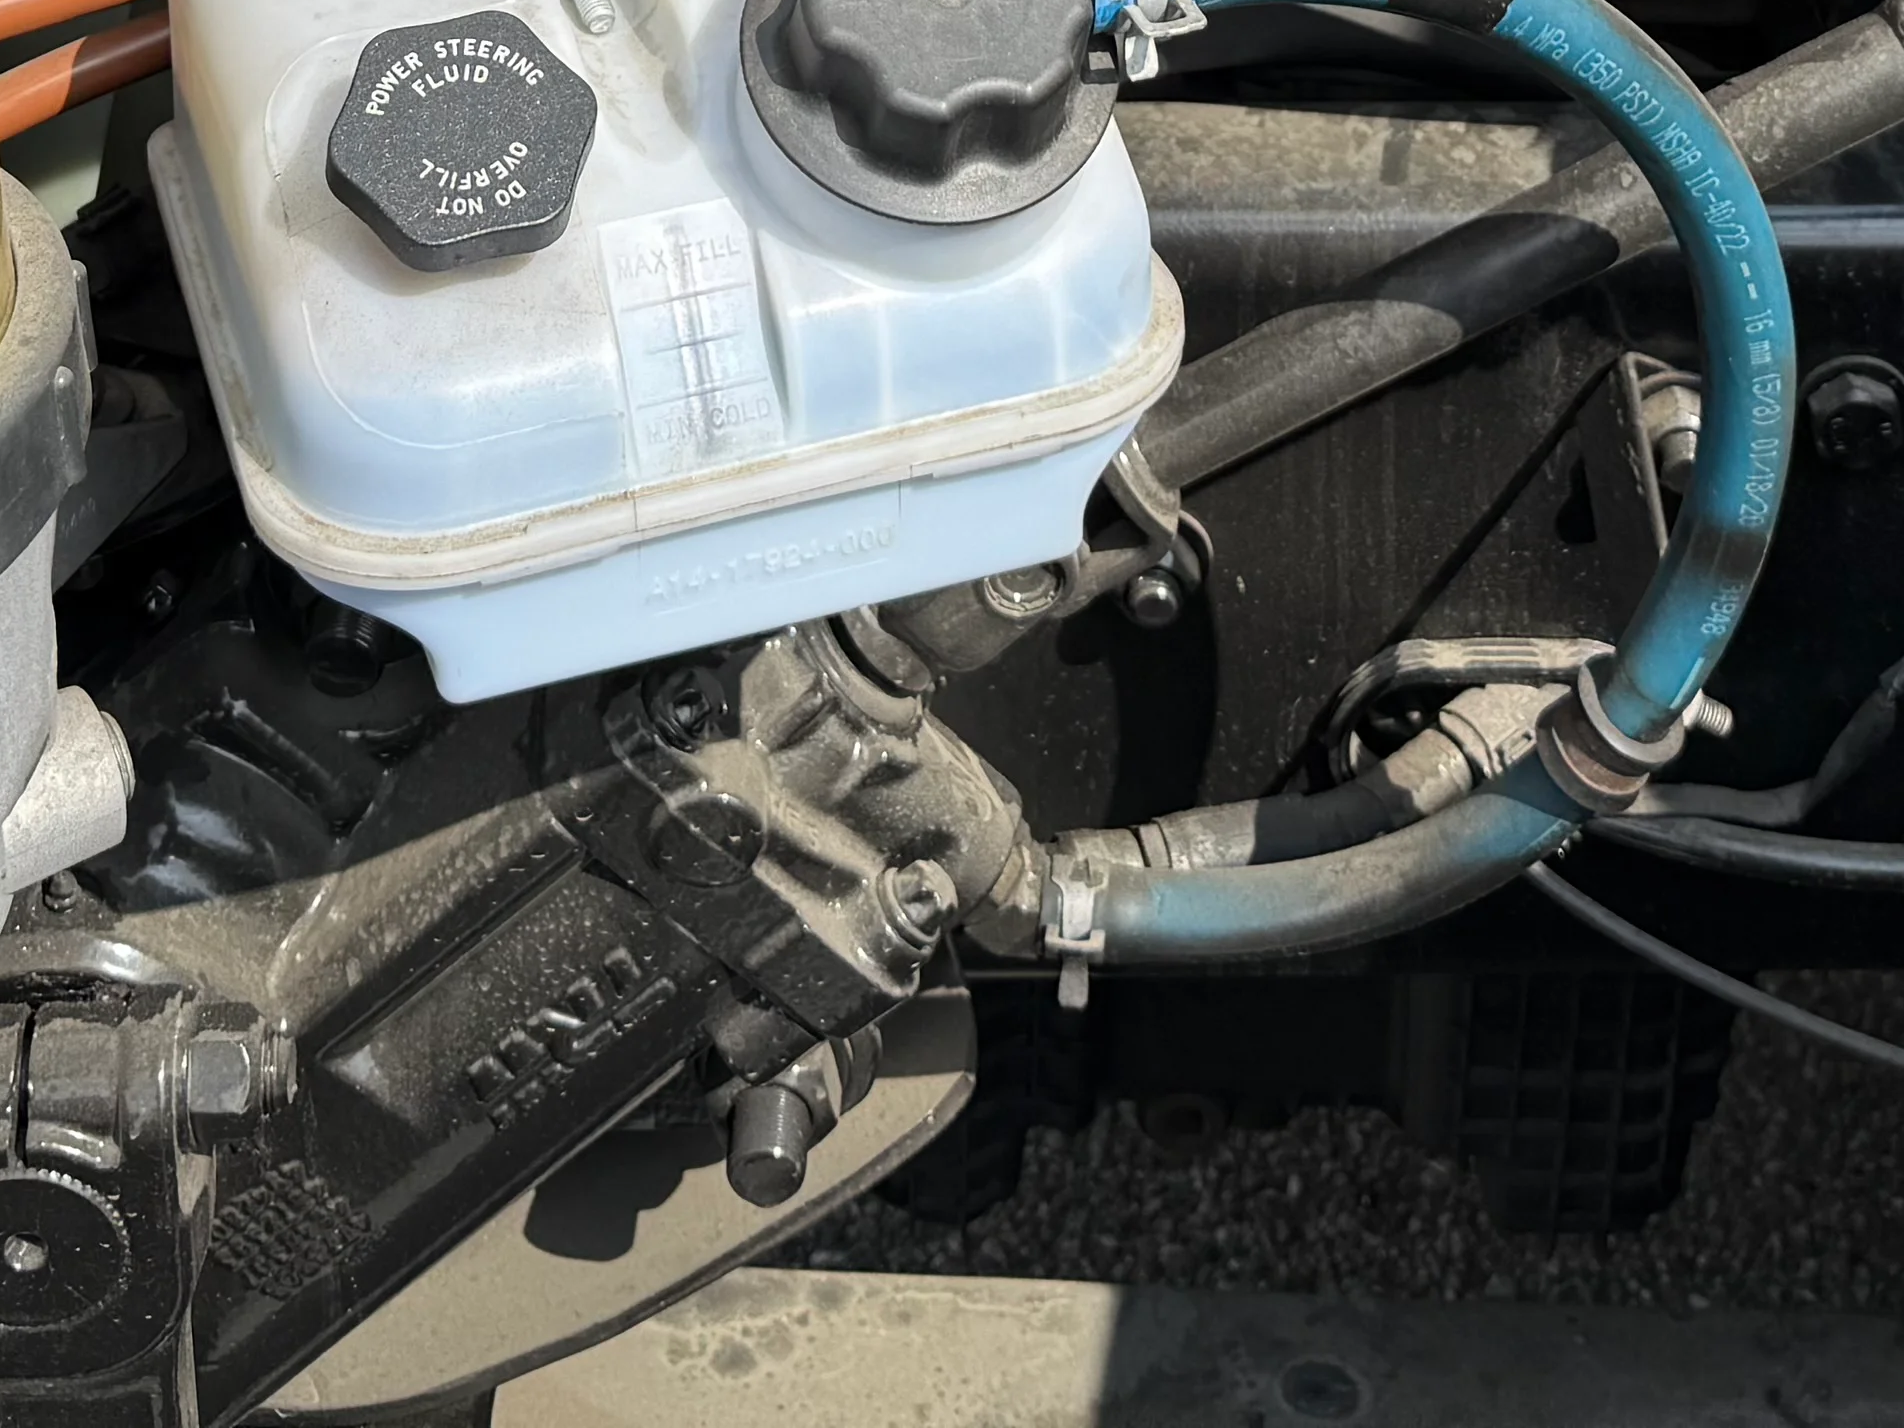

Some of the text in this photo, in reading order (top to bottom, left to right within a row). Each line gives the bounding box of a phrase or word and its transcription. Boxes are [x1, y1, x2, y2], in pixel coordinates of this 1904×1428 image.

[1527, 22, 1571, 62] MPa
[365, 37, 546, 118] POWER STEERING
[410, 62, 490, 99] FLUID
[1571, 46, 1624, 92] (350
[1613, 79, 1666, 128] PSI)
[418, 140, 529, 192] OVERFILL
[1650, 120, 1704, 173] MSHA
[435, 179, 528, 218] DO NOT
[616, 250, 669, 283] MAX
[1743, 308, 1775, 334] 16
[1748, 341, 1772, 366] mm
[709, 394, 773, 430] COLD
[1751, 372, 1783, 427] (5/8)
